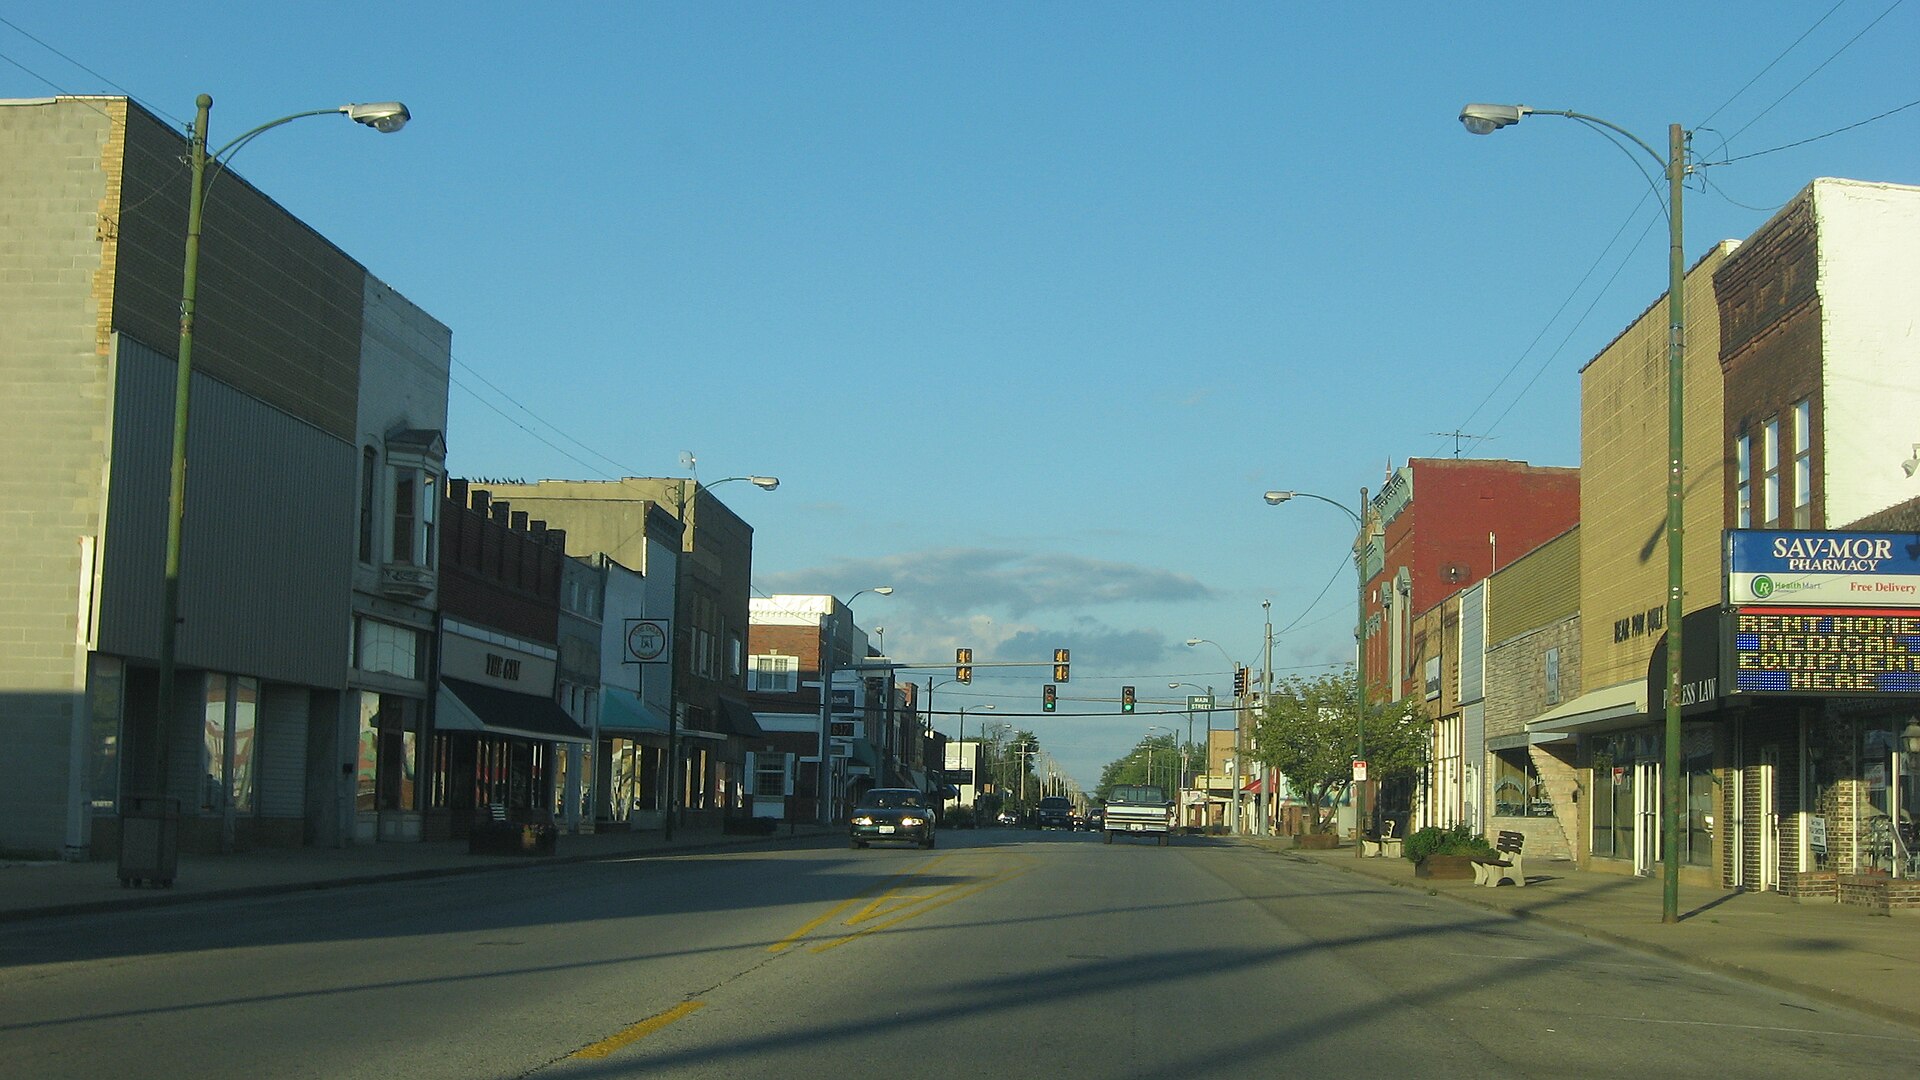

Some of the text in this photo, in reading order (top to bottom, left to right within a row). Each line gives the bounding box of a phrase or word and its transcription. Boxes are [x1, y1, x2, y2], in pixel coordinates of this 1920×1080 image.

[1772, 537, 1893, 559] SAV-MOR
[1788, 558, 1879, 572] PHARMACY
[1850, 582, 1917, 595] Free Delivery
[1738, 615, 1920, 634] RENT HOME
[1760, 634, 1908, 653] MEDICAL
[1738, 653, 1920, 671] EQUIPMENT
[1698, 677, 1717, 703] LAW
[1791, 671, 1876, 690] HERE
